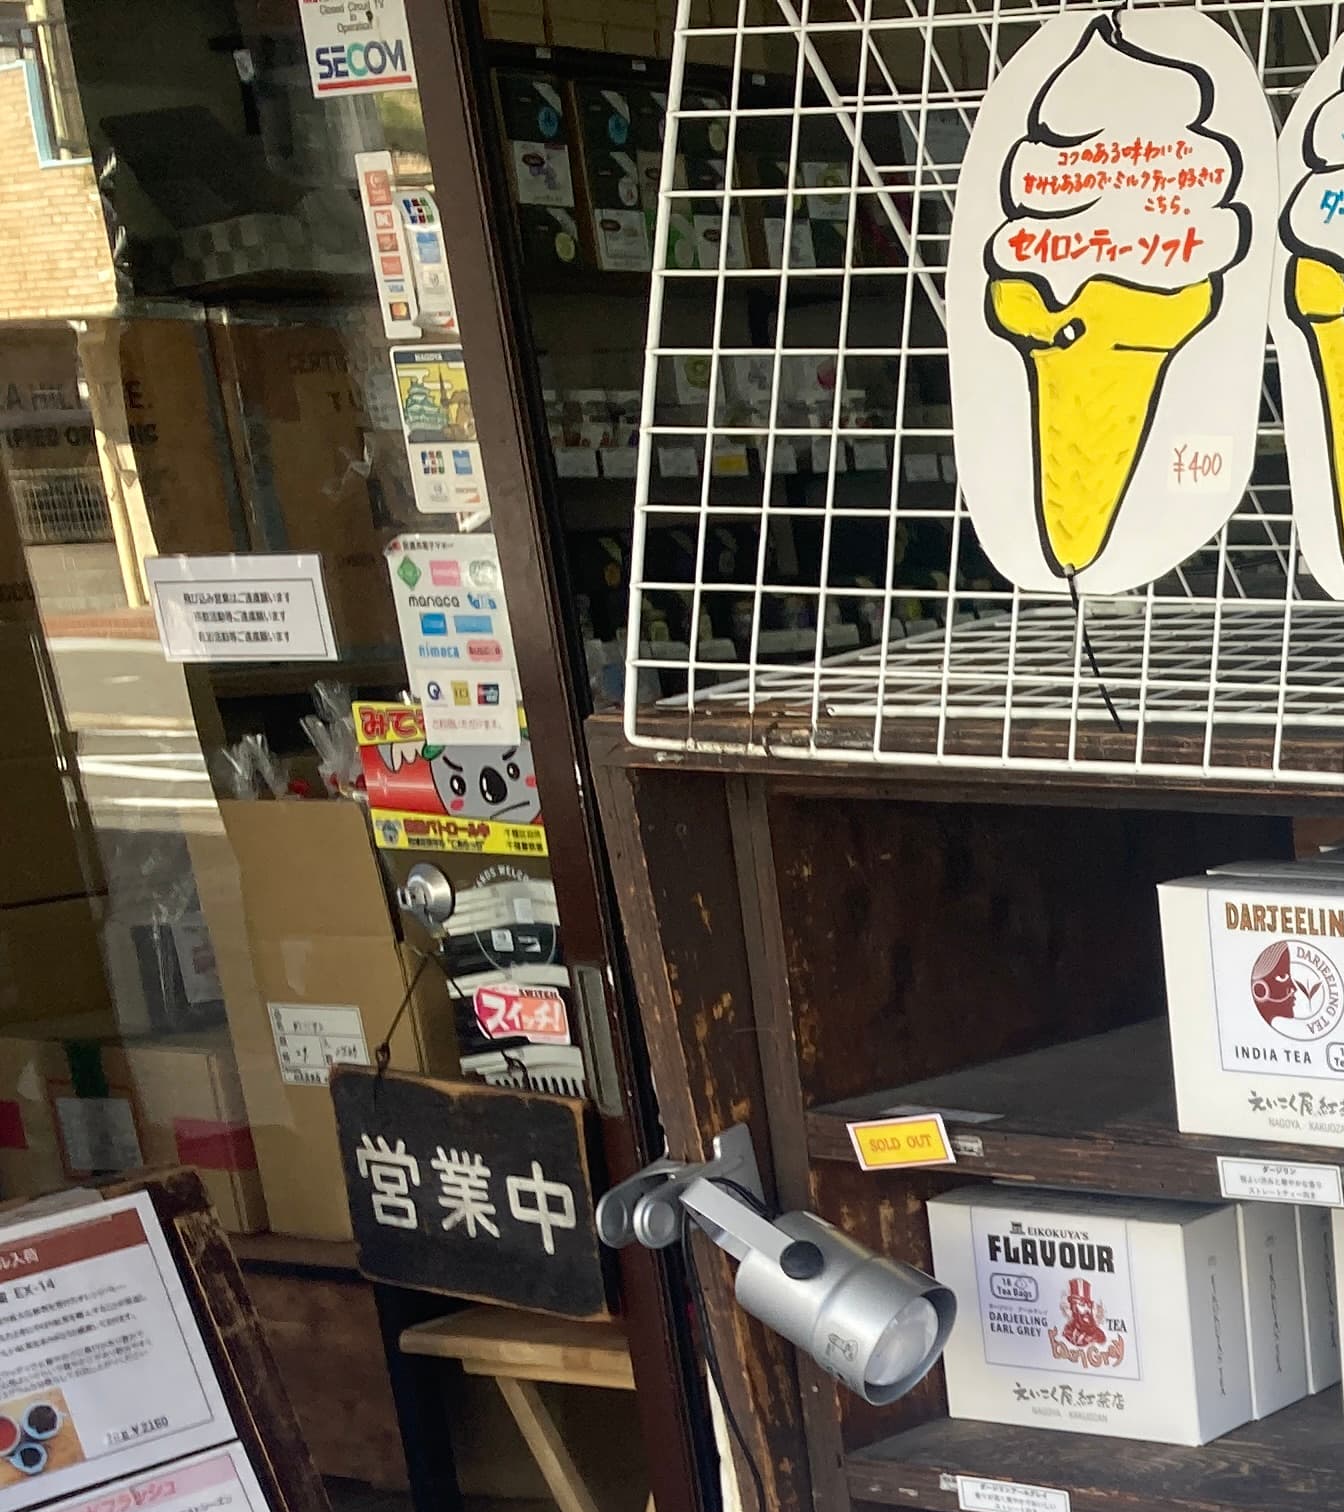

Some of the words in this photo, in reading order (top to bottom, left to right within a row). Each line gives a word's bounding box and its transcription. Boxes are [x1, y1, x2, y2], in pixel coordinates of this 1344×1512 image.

[315, 40, 407, 79] SECOM
[1173, 444, 1223, 478] ¥400
[360, 708, 424, 739] みて
[1234, 1045, 1278, 1065] INDIA
[1285, 1048, 1312, 1066] TEA
[868, 1134, 901, 1153] SOLD
[907, 1133, 932, 1151] OUT
[356, 1133, 577, 1256] 営業中
[988, 1234, 1115, 1274] FLAVOUR
[989, 1311, 1048, 1327] DARJEELING
